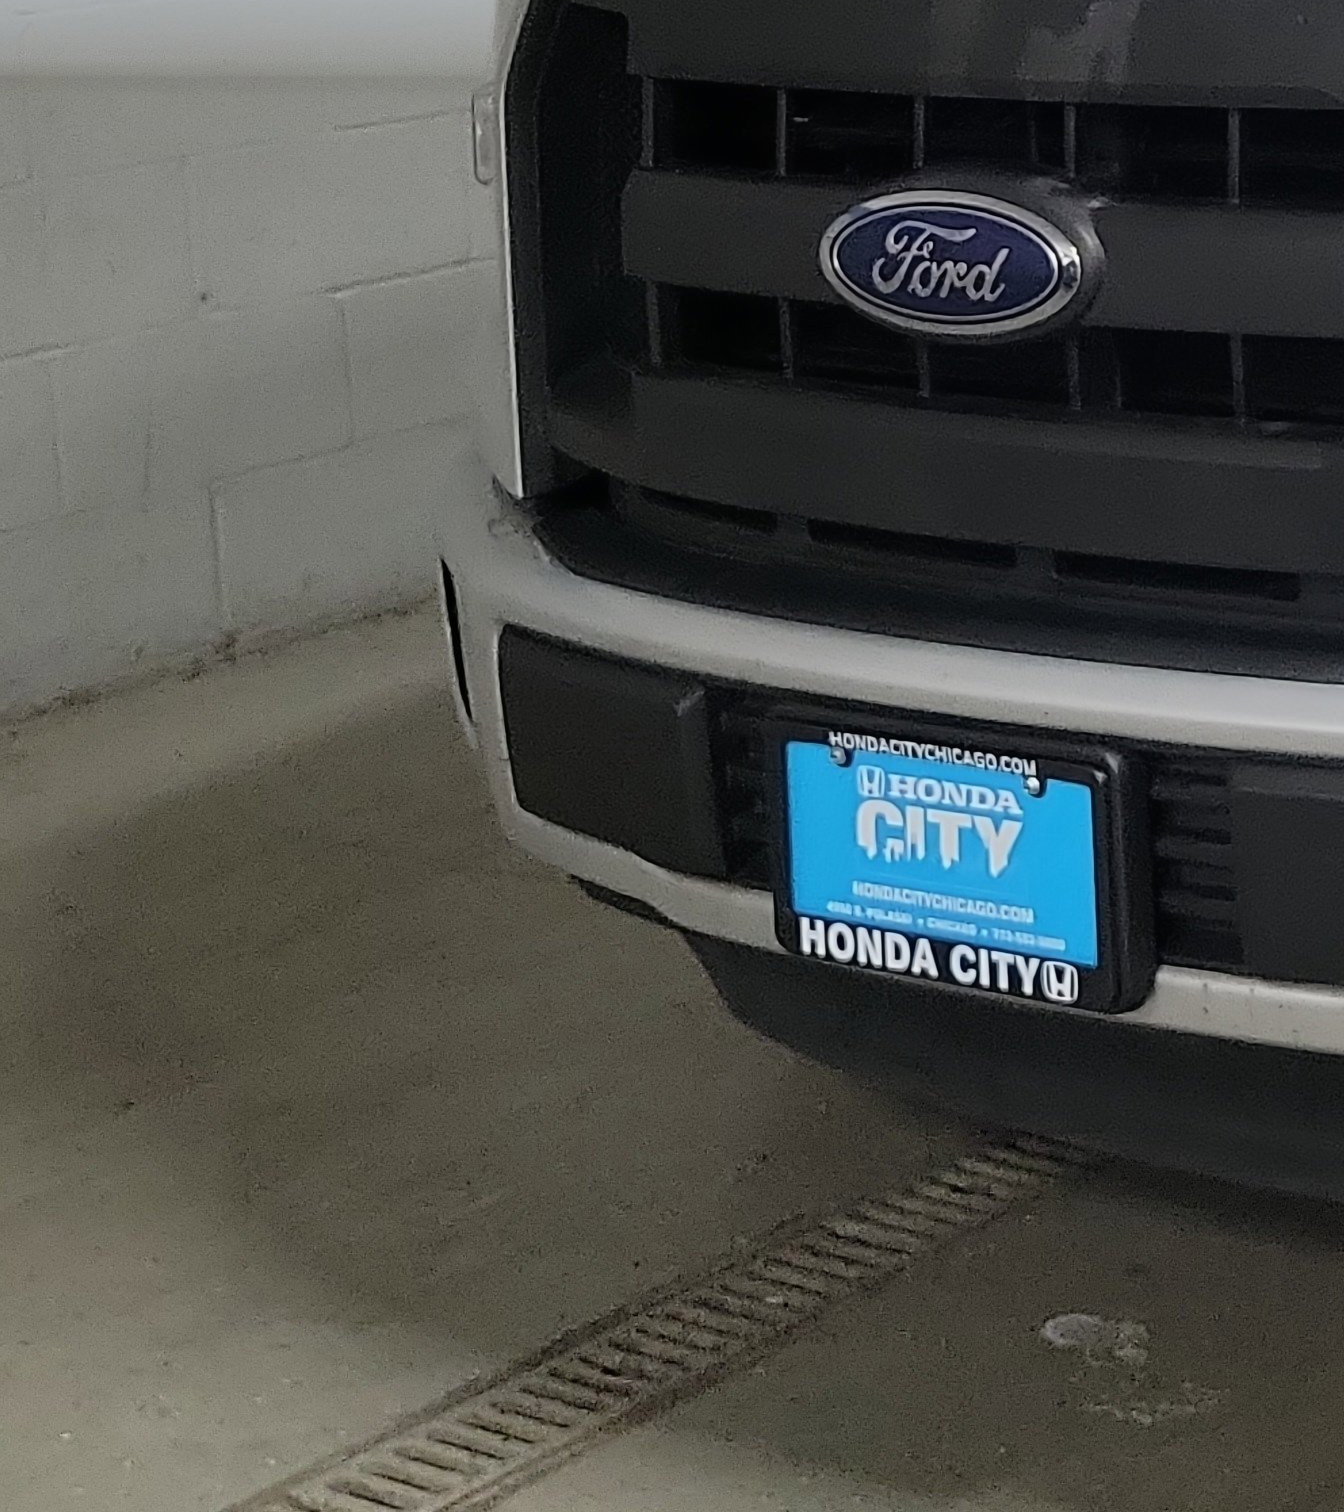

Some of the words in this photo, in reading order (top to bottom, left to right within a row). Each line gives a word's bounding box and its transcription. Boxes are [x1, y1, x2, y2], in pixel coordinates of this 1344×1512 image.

[872, 219, 1010, 302] Ford
[829, 731, 1037, 775] HONDACITYCHICAGO.COM
[887, 773, 1024, 815] HONDA
[856, 799, 1024, 878] CITY
[852, 880, 1034, 923] HONDACITYCHICAGO.COM
[800, 915, 939, 980] HONDA
[949, 944, 1041, 996] CITY
